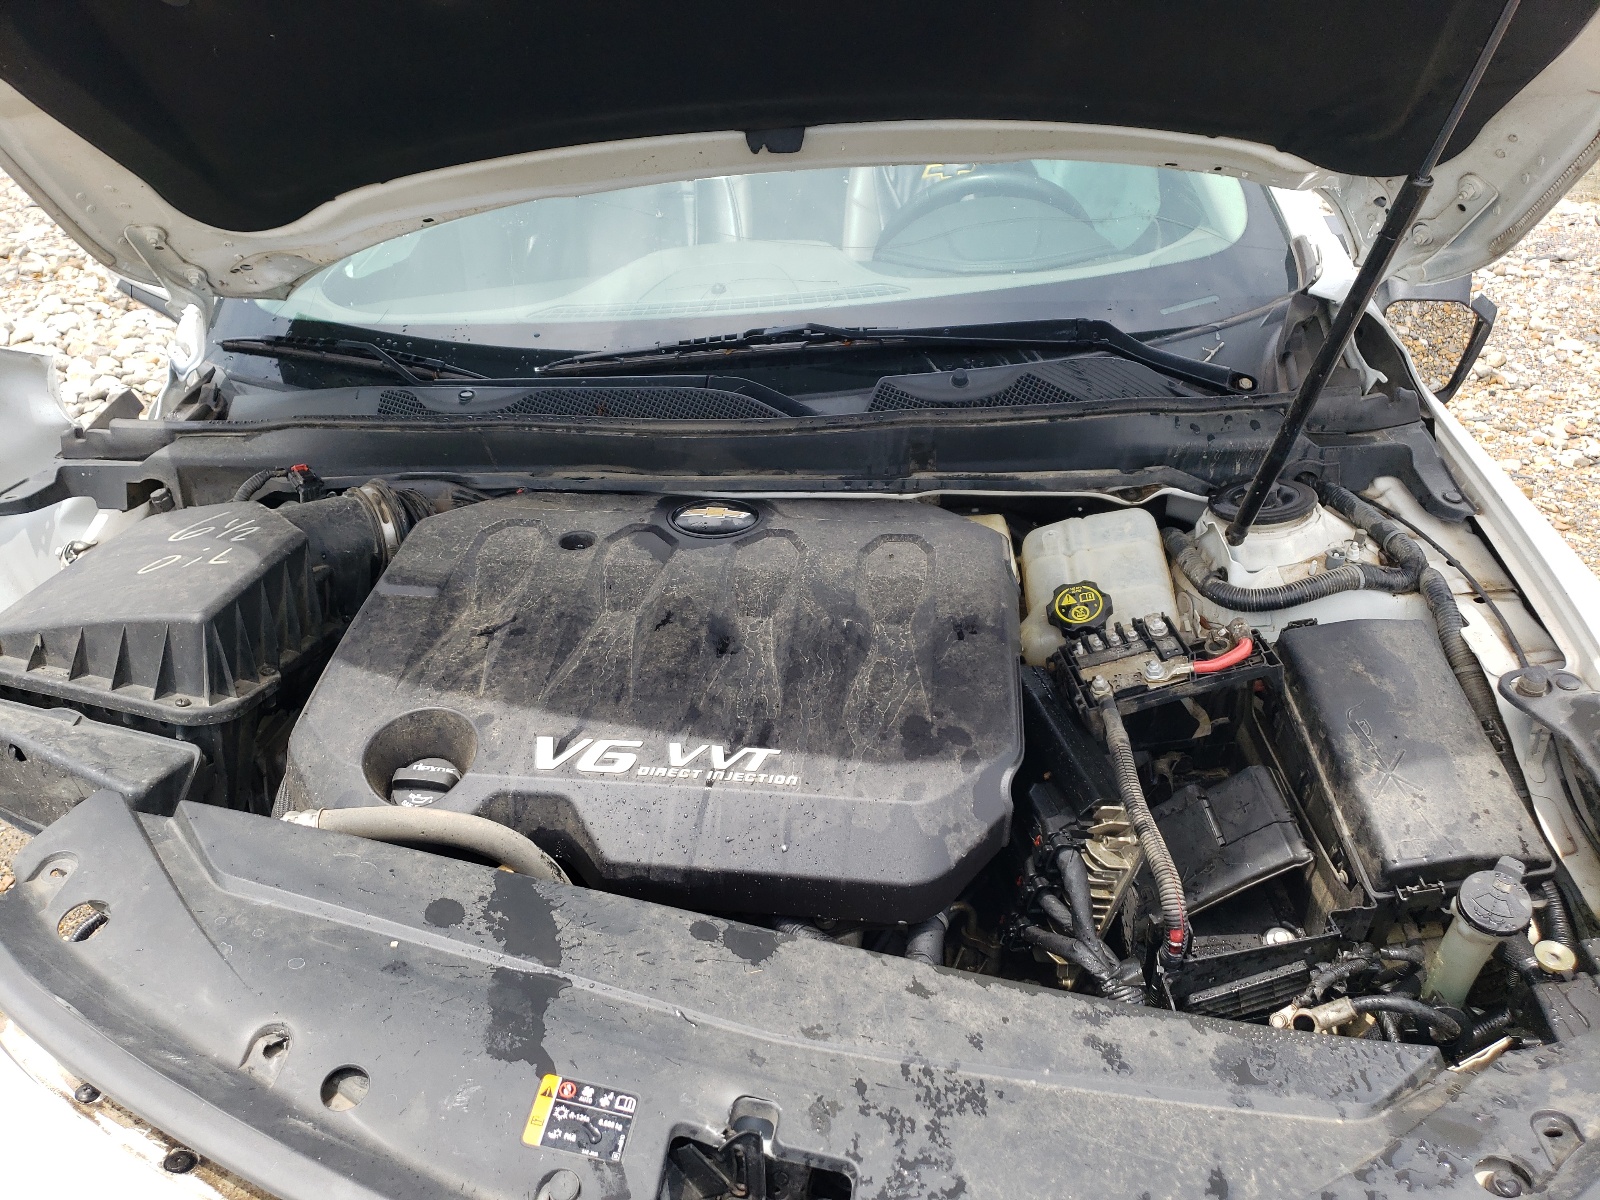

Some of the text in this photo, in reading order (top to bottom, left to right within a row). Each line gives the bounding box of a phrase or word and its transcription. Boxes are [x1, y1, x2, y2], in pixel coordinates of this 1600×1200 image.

[535, 736, 782, 774] V6 VVT
[637, 765, 702, 780] DIRECT
